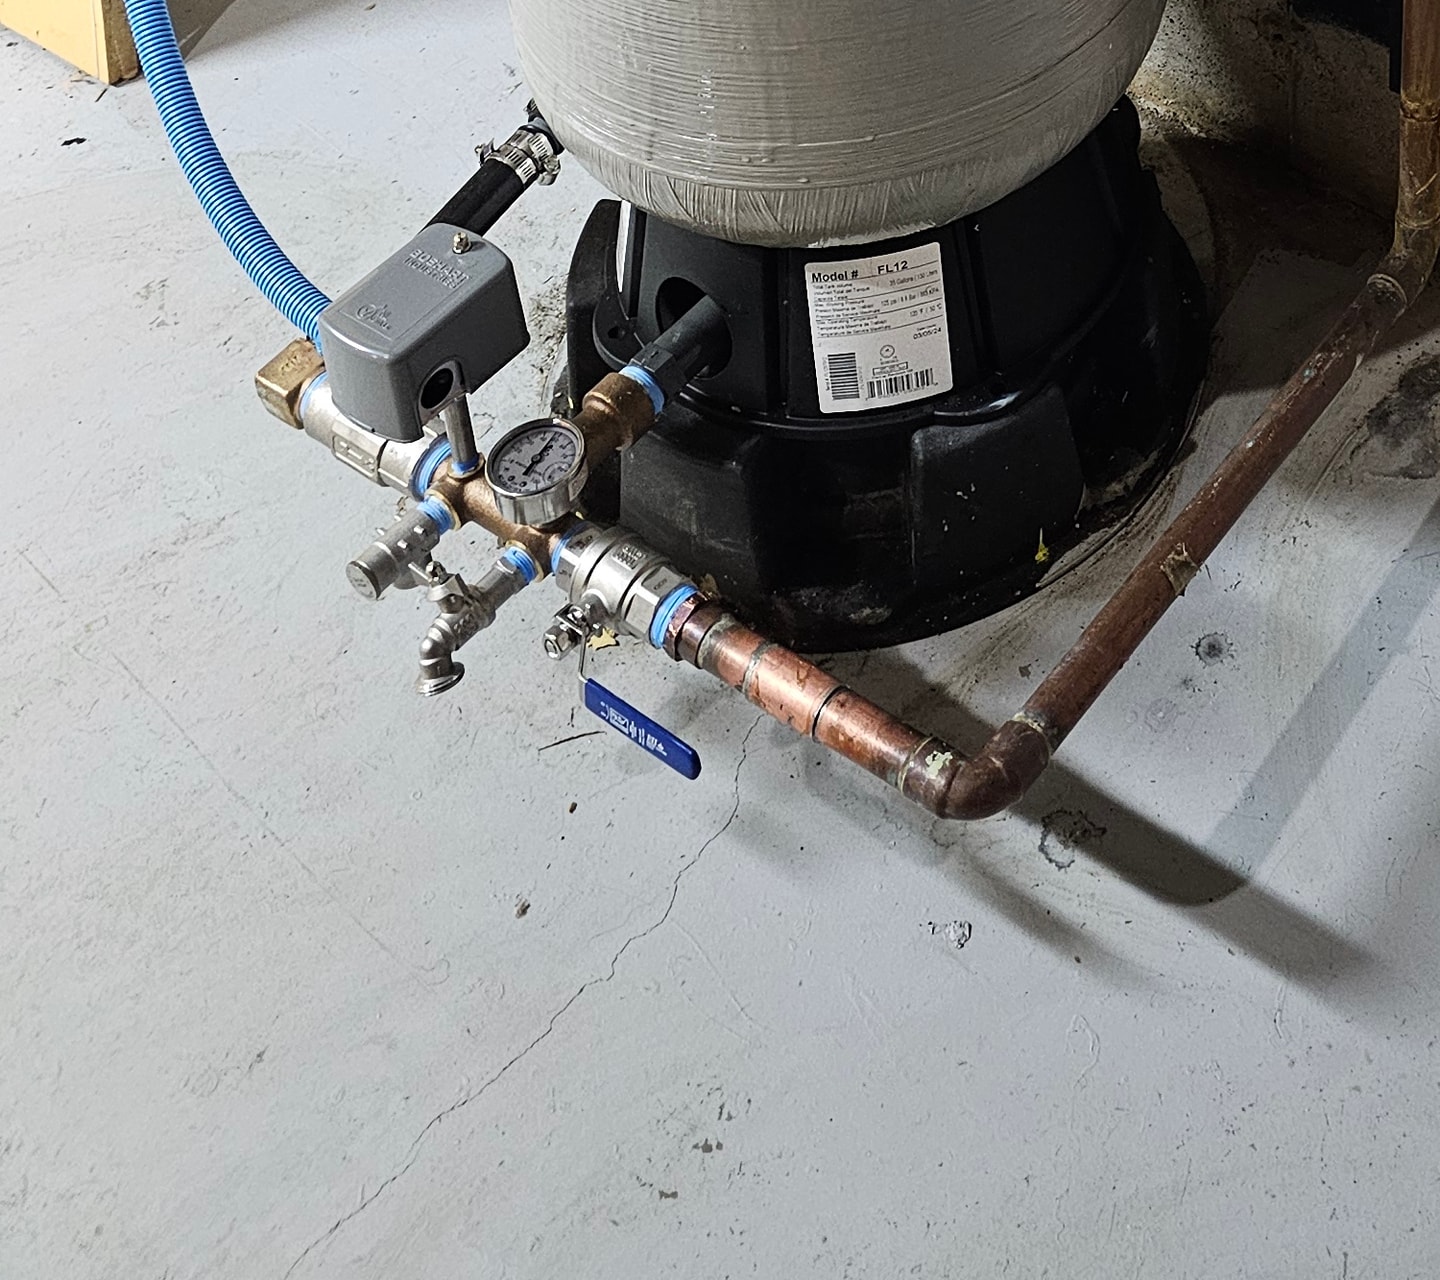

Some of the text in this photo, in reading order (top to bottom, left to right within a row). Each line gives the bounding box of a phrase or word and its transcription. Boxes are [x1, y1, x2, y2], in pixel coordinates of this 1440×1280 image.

[812, 260, 908, 283] Model # FL12
